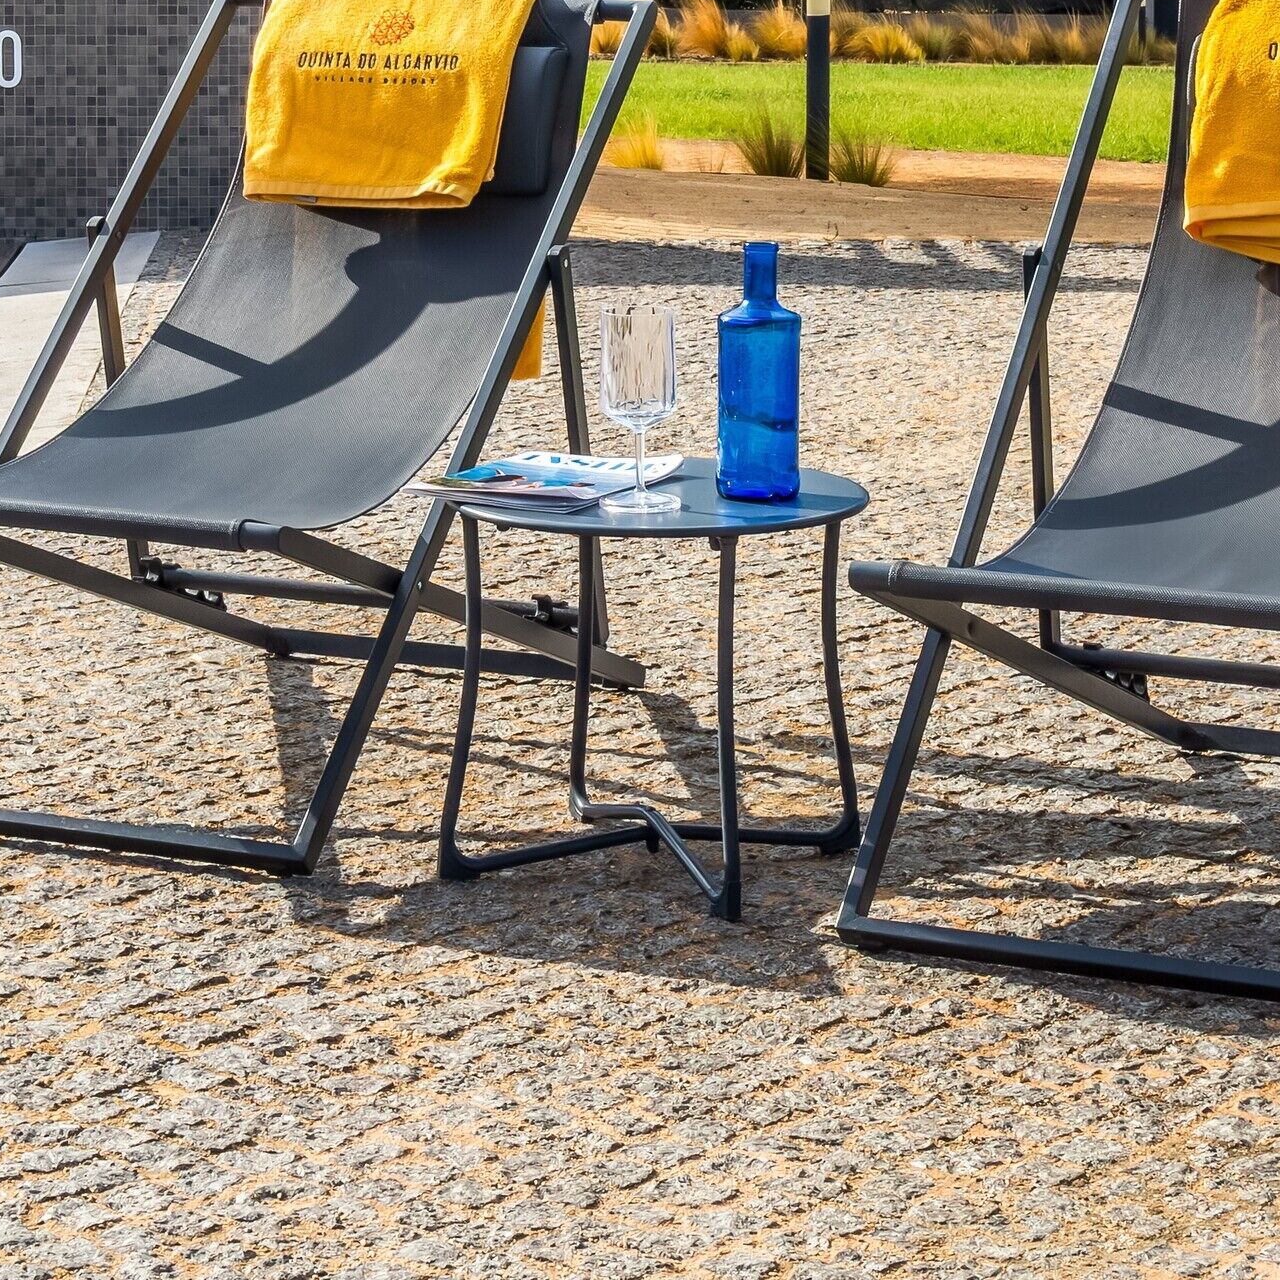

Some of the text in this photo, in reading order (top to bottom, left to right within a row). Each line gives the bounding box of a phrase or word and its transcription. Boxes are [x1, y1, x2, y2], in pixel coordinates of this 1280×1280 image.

[298, 51, 459, 71] QUINTA DO ALGARVIO
